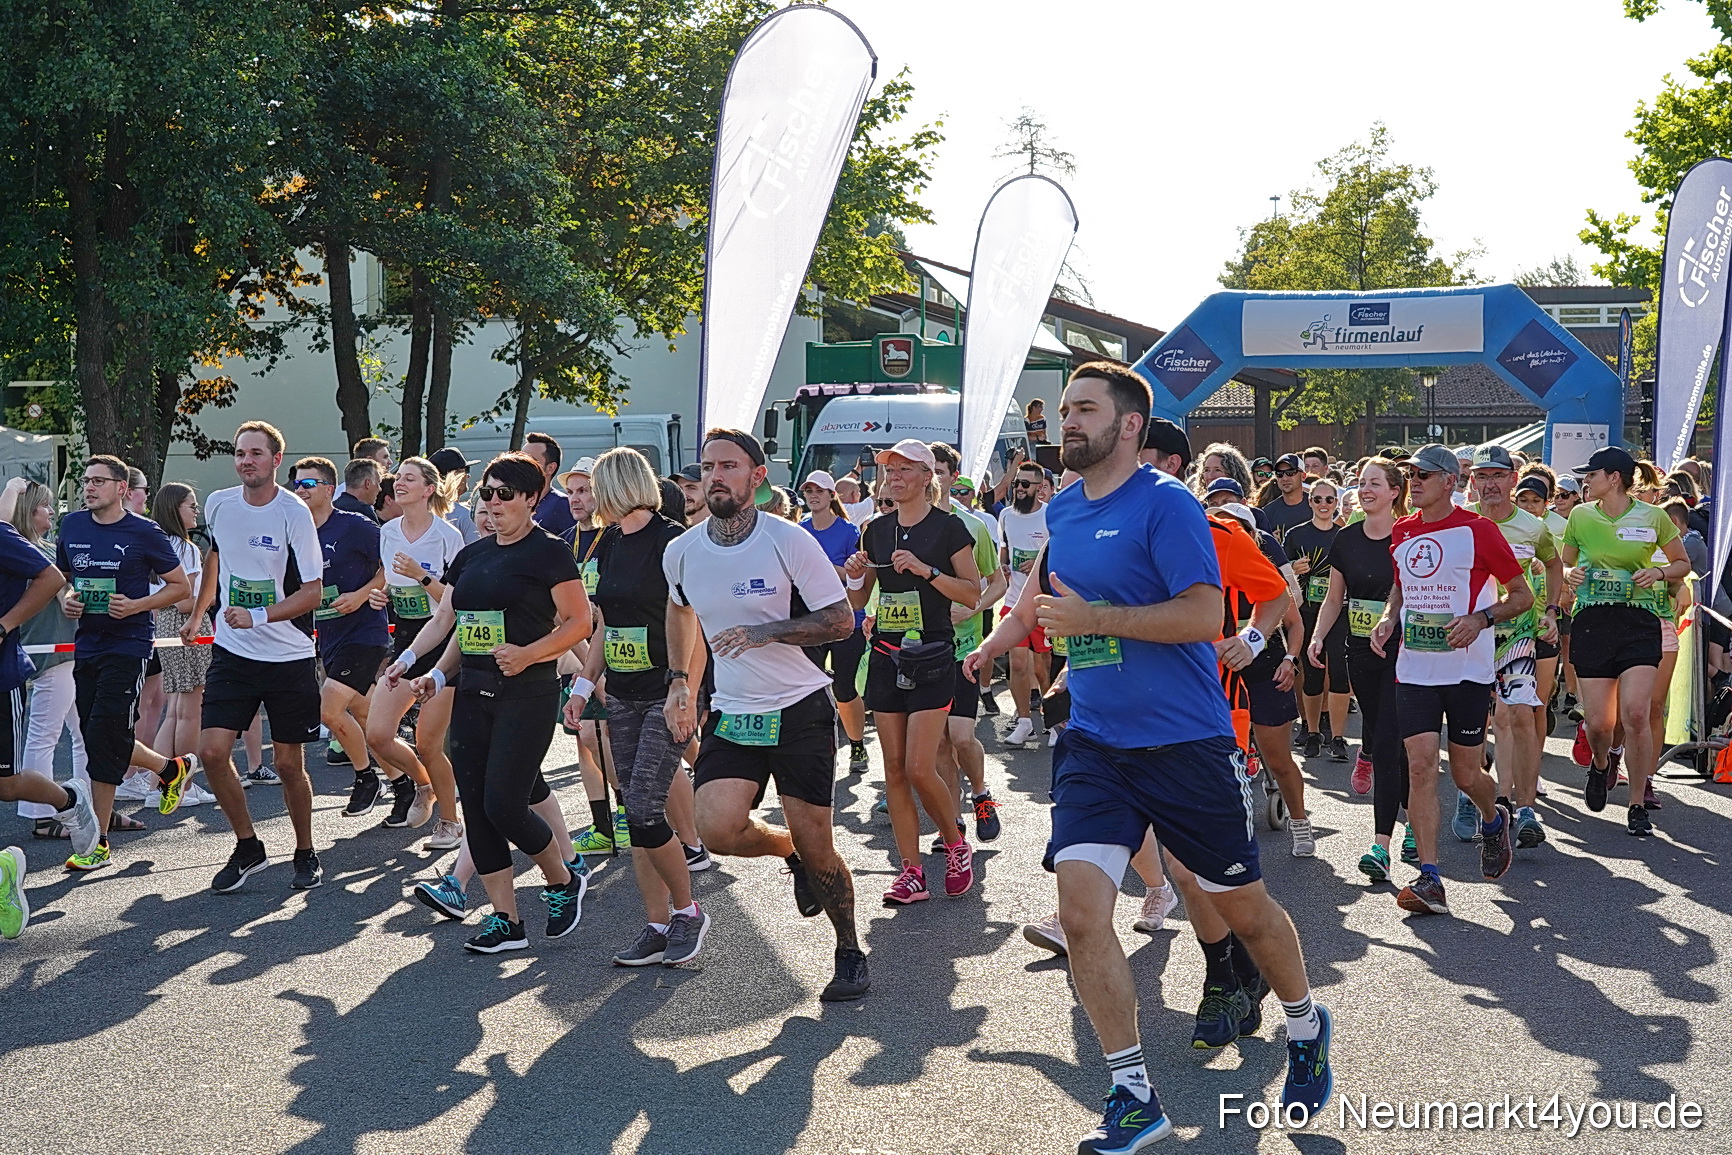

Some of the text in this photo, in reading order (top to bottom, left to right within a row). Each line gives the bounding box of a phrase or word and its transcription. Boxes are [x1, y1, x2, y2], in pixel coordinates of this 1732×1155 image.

[761, 46, 830, 191] Fischer
[1690, 185, 1732, 288] Fischer
[1357, 310, 1388, 319] Fischer
[1335, 324, 1425, 344] firmenlauf
[1163, 356, 1212, 367] Fischer
[820, 421, 861, 432] abavent
[894, 424, 952, 432] DATASPORT
[1598, 580, 1622, 592] 203
[80, 590, 108, 602] 1782
[238, 591, 263, 605] 519
[396, 597, 418, 608] 516
[884, 605, 908, 619] 744
[1351, 611, 1372, 625] 743
[466, 626, 491, 641] 748
[1411, 625, 1446, 640] 1496
[611, 643, 635, 657] 749
[1088, 647, 1105, 655] Peter
[733, 714, 764, 731] 518
[769, 717, 778, 739] 2022
